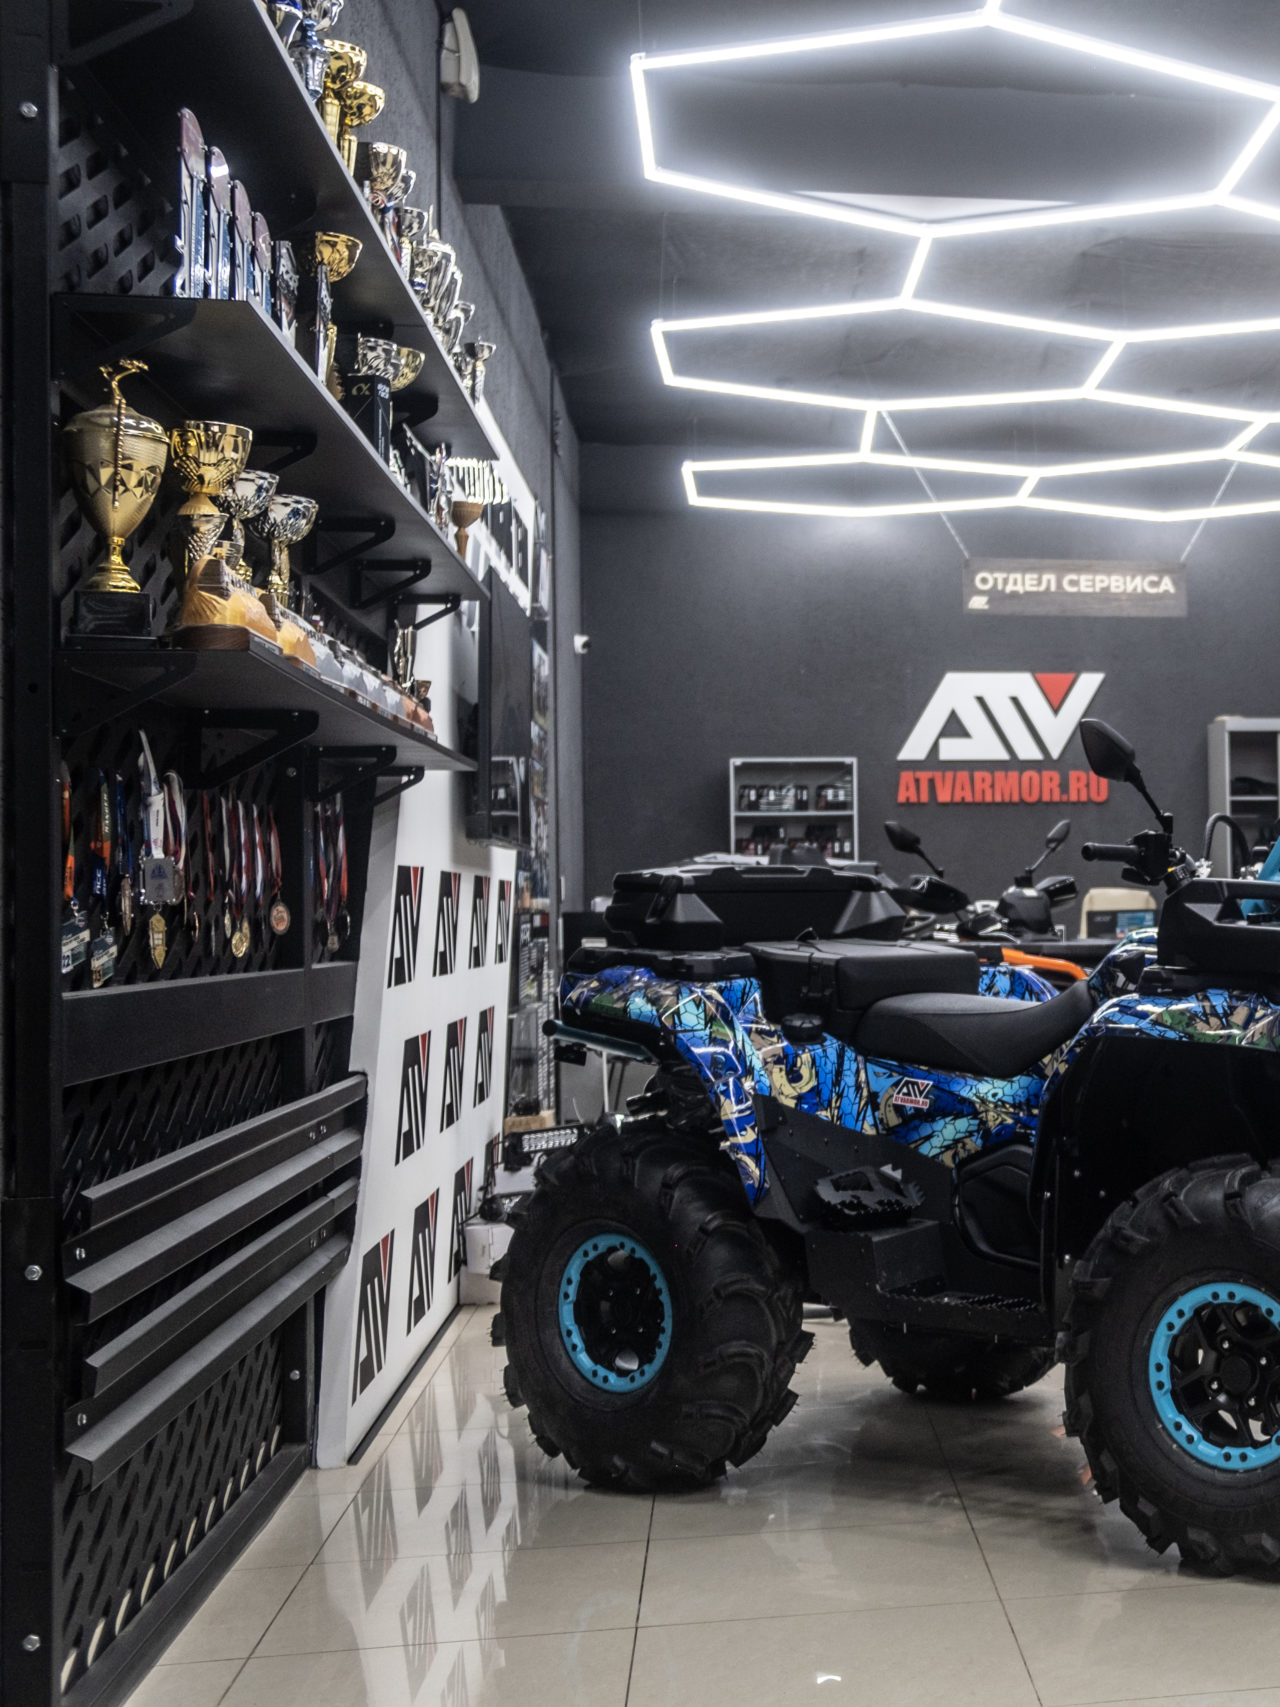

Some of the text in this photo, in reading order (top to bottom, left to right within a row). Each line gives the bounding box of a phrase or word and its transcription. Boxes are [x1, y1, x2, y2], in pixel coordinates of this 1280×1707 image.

[974, 571, 1176, 594] ОТДЕЛ СЕРВИСА
[896, 770, 1109, 804] ATVARMOR.RU
